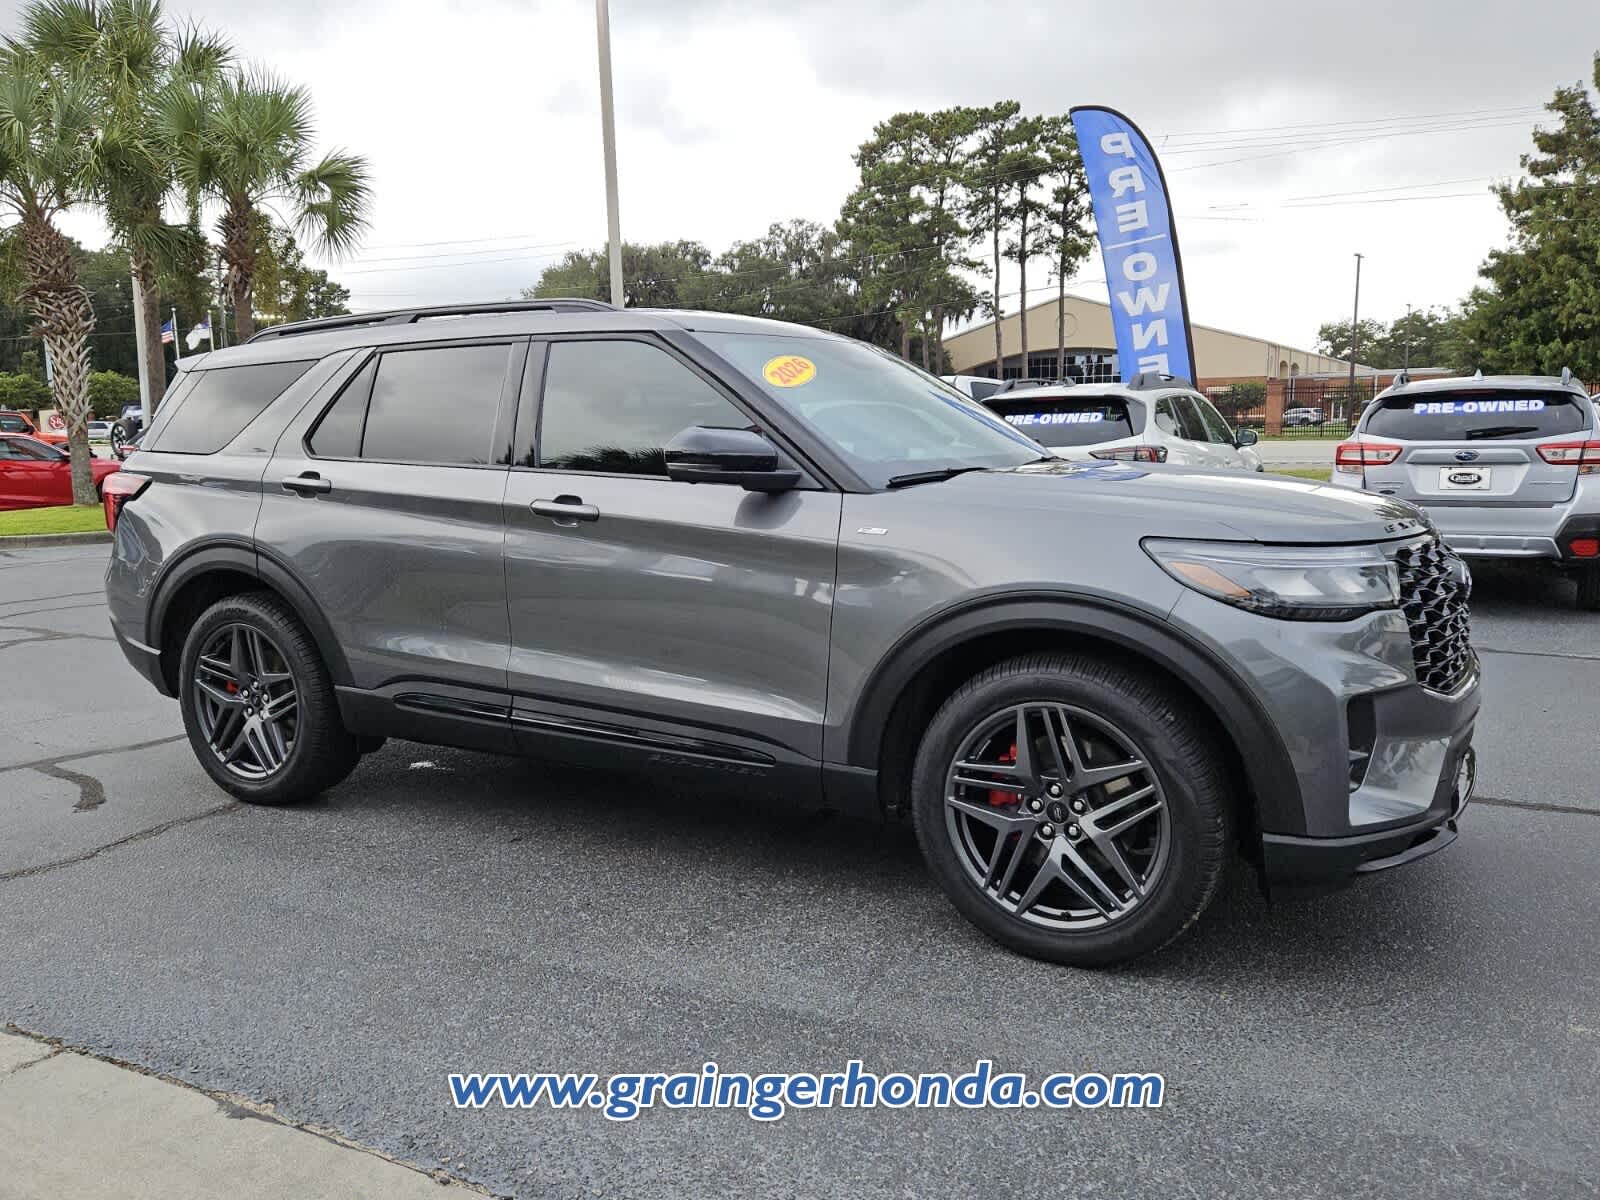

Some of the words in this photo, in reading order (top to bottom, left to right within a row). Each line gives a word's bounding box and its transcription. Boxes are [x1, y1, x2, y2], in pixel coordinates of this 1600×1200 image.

[769, 358, 810, 385] 2026
[1413, 400, 1545, 414] PRE-OWNED
[1004, 412, 1103, 425] PRE-OWNED
